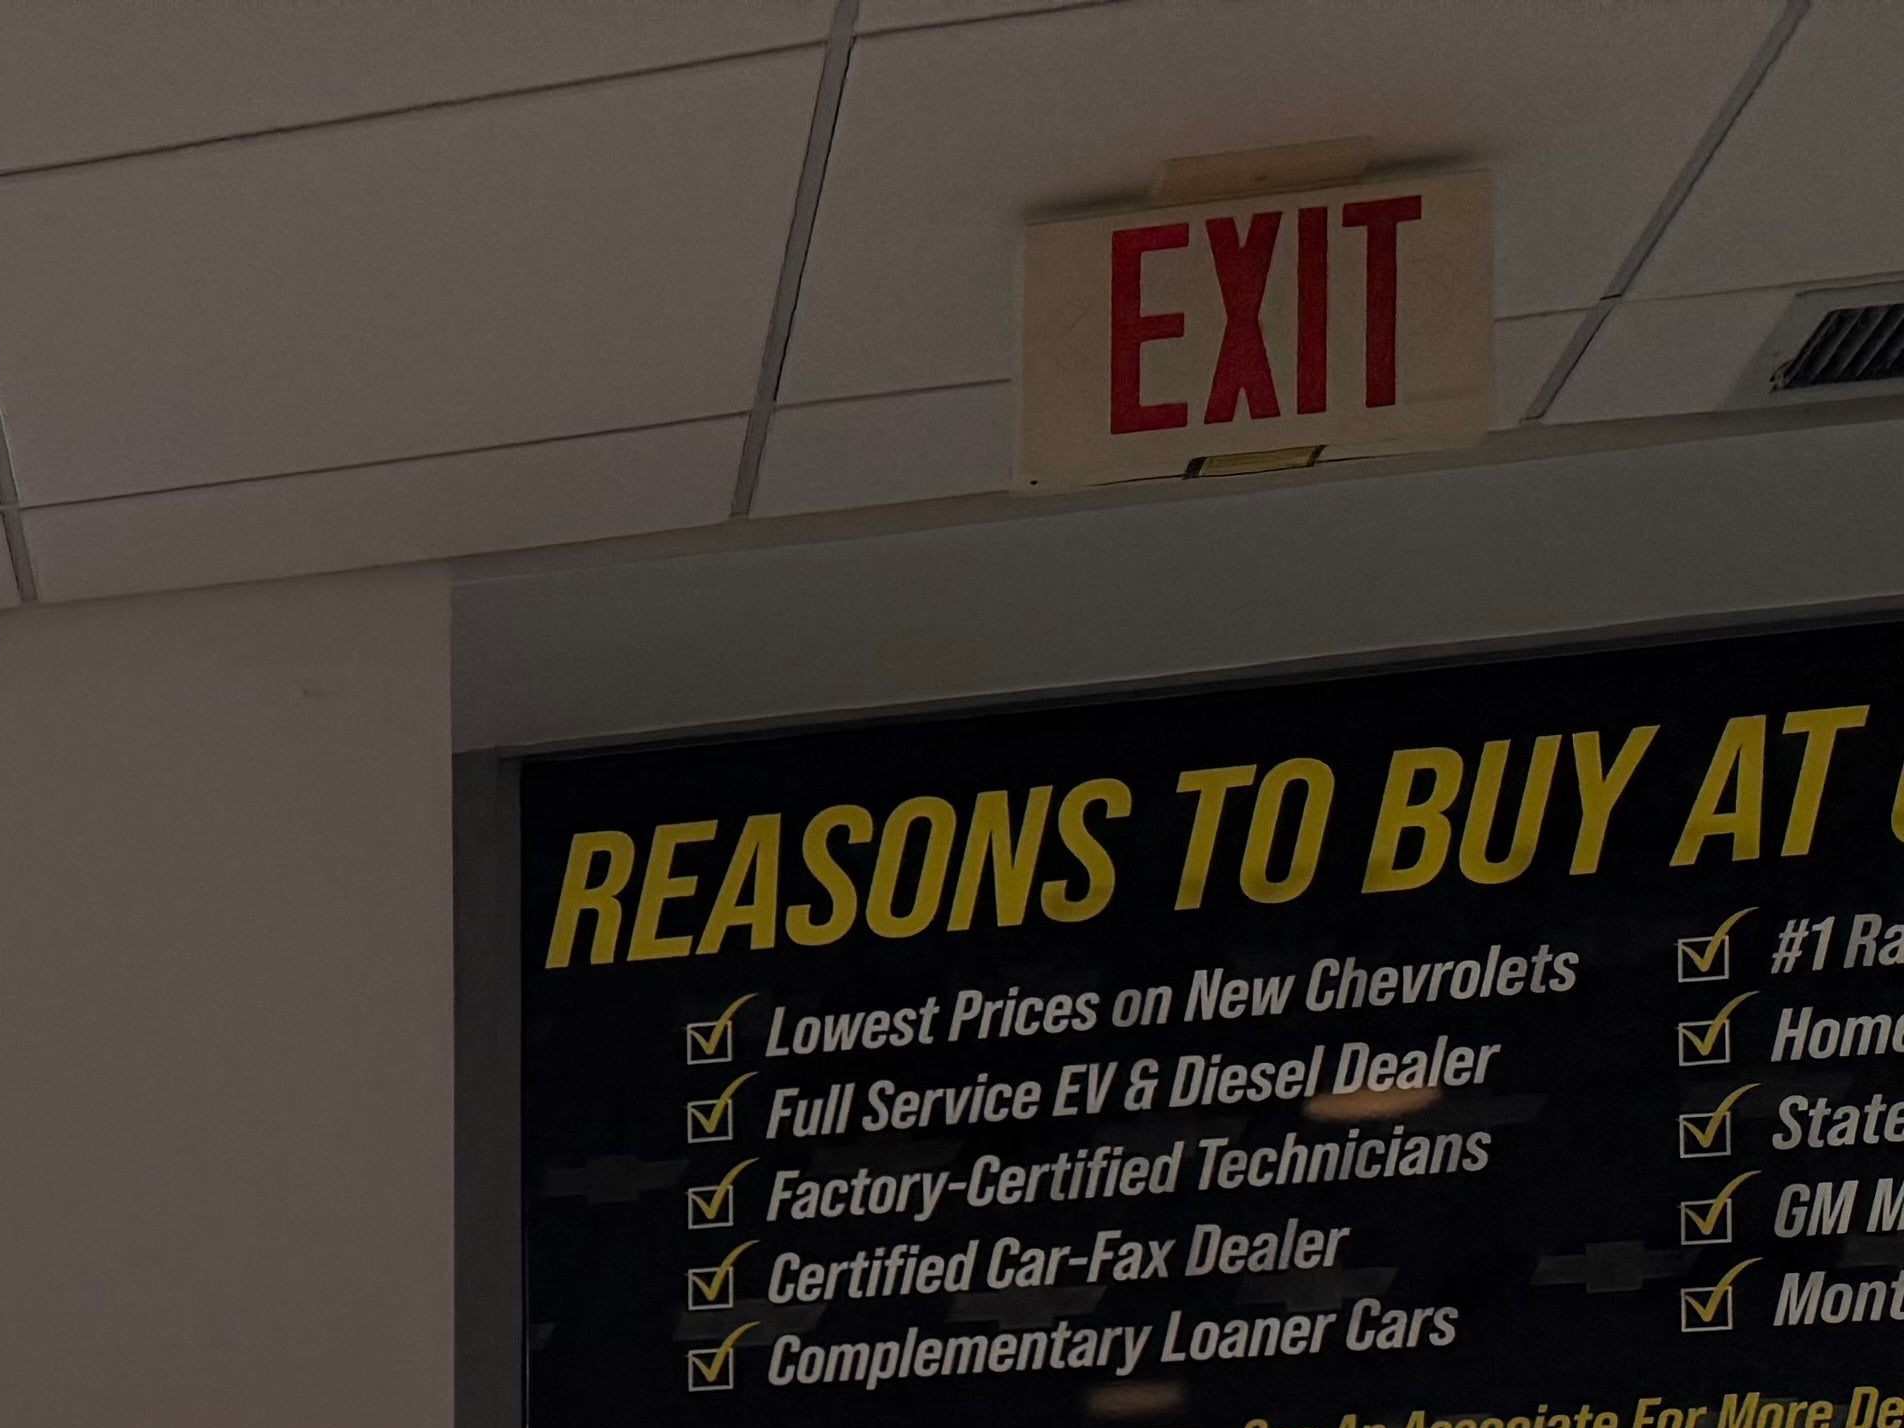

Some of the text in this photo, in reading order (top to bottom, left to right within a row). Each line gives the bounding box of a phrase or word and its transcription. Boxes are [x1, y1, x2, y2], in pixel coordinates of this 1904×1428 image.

[1110, 194, 1422, 435] EXIT
[545, 778, 1132, 969] REASONS
[1173, 757, 1335, 910] TO
[1361, 724, 1661, 894] BUY
[1669, 704, 1871, 867] AT
[1770, 916, 1835, 975] #1
[765, 943, 1579, 1058] Lowest Prices on New Chevrolets
[766, 1034, 1502, 1140] Full Service EV & Diesel Dealer
[766, 1126, 1491, 1223] Factory-Certified Technicians
[1774, 1180, 1860, 1239] GM
[767, 1218, 1351, 1305] Certified Car-Fax Dealer
[767, 1297, 1458, 1391] Complementary Loaner Cars
